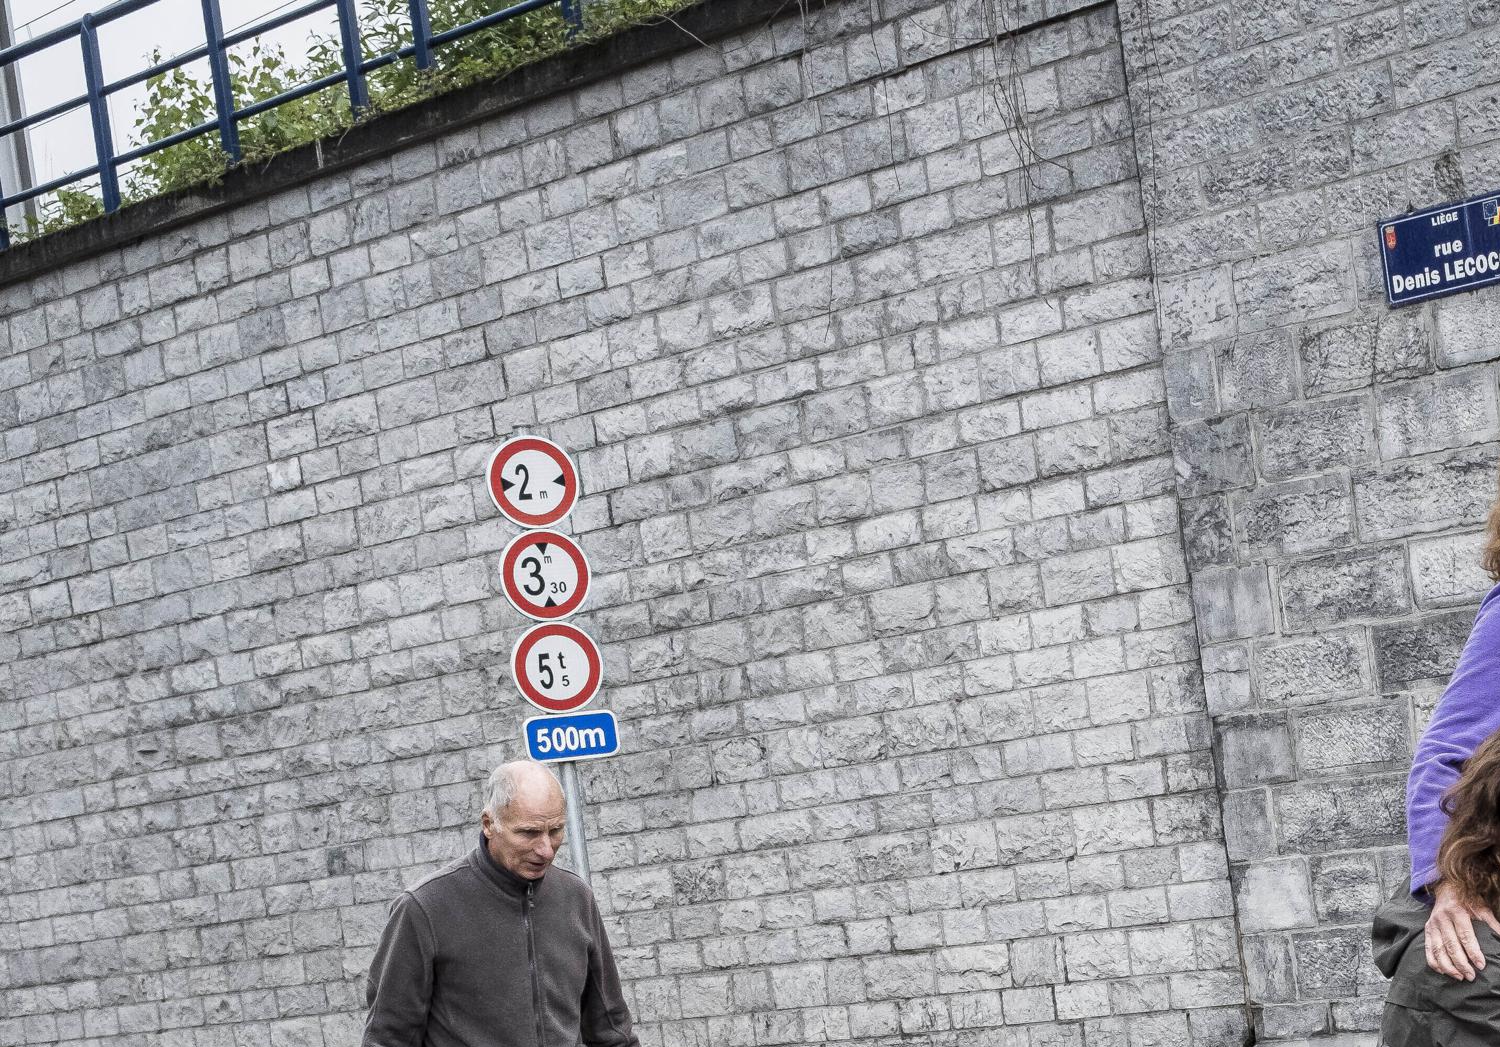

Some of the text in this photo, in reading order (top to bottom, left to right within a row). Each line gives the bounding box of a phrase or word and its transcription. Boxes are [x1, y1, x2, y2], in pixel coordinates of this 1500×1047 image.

[1431, 212, 1459, 226] LIÈGE
[1434, 240, 1463, 257] rue
[1392, 267, 1441, 293] Denis
[515, 464, 548, 500] 2 m
[521, 556, 545, 596] 3
[550, 581, 567, 594] 30
[538, 652, 570, 689] 5 t 5
[536, 726, 606, 753] 500m
